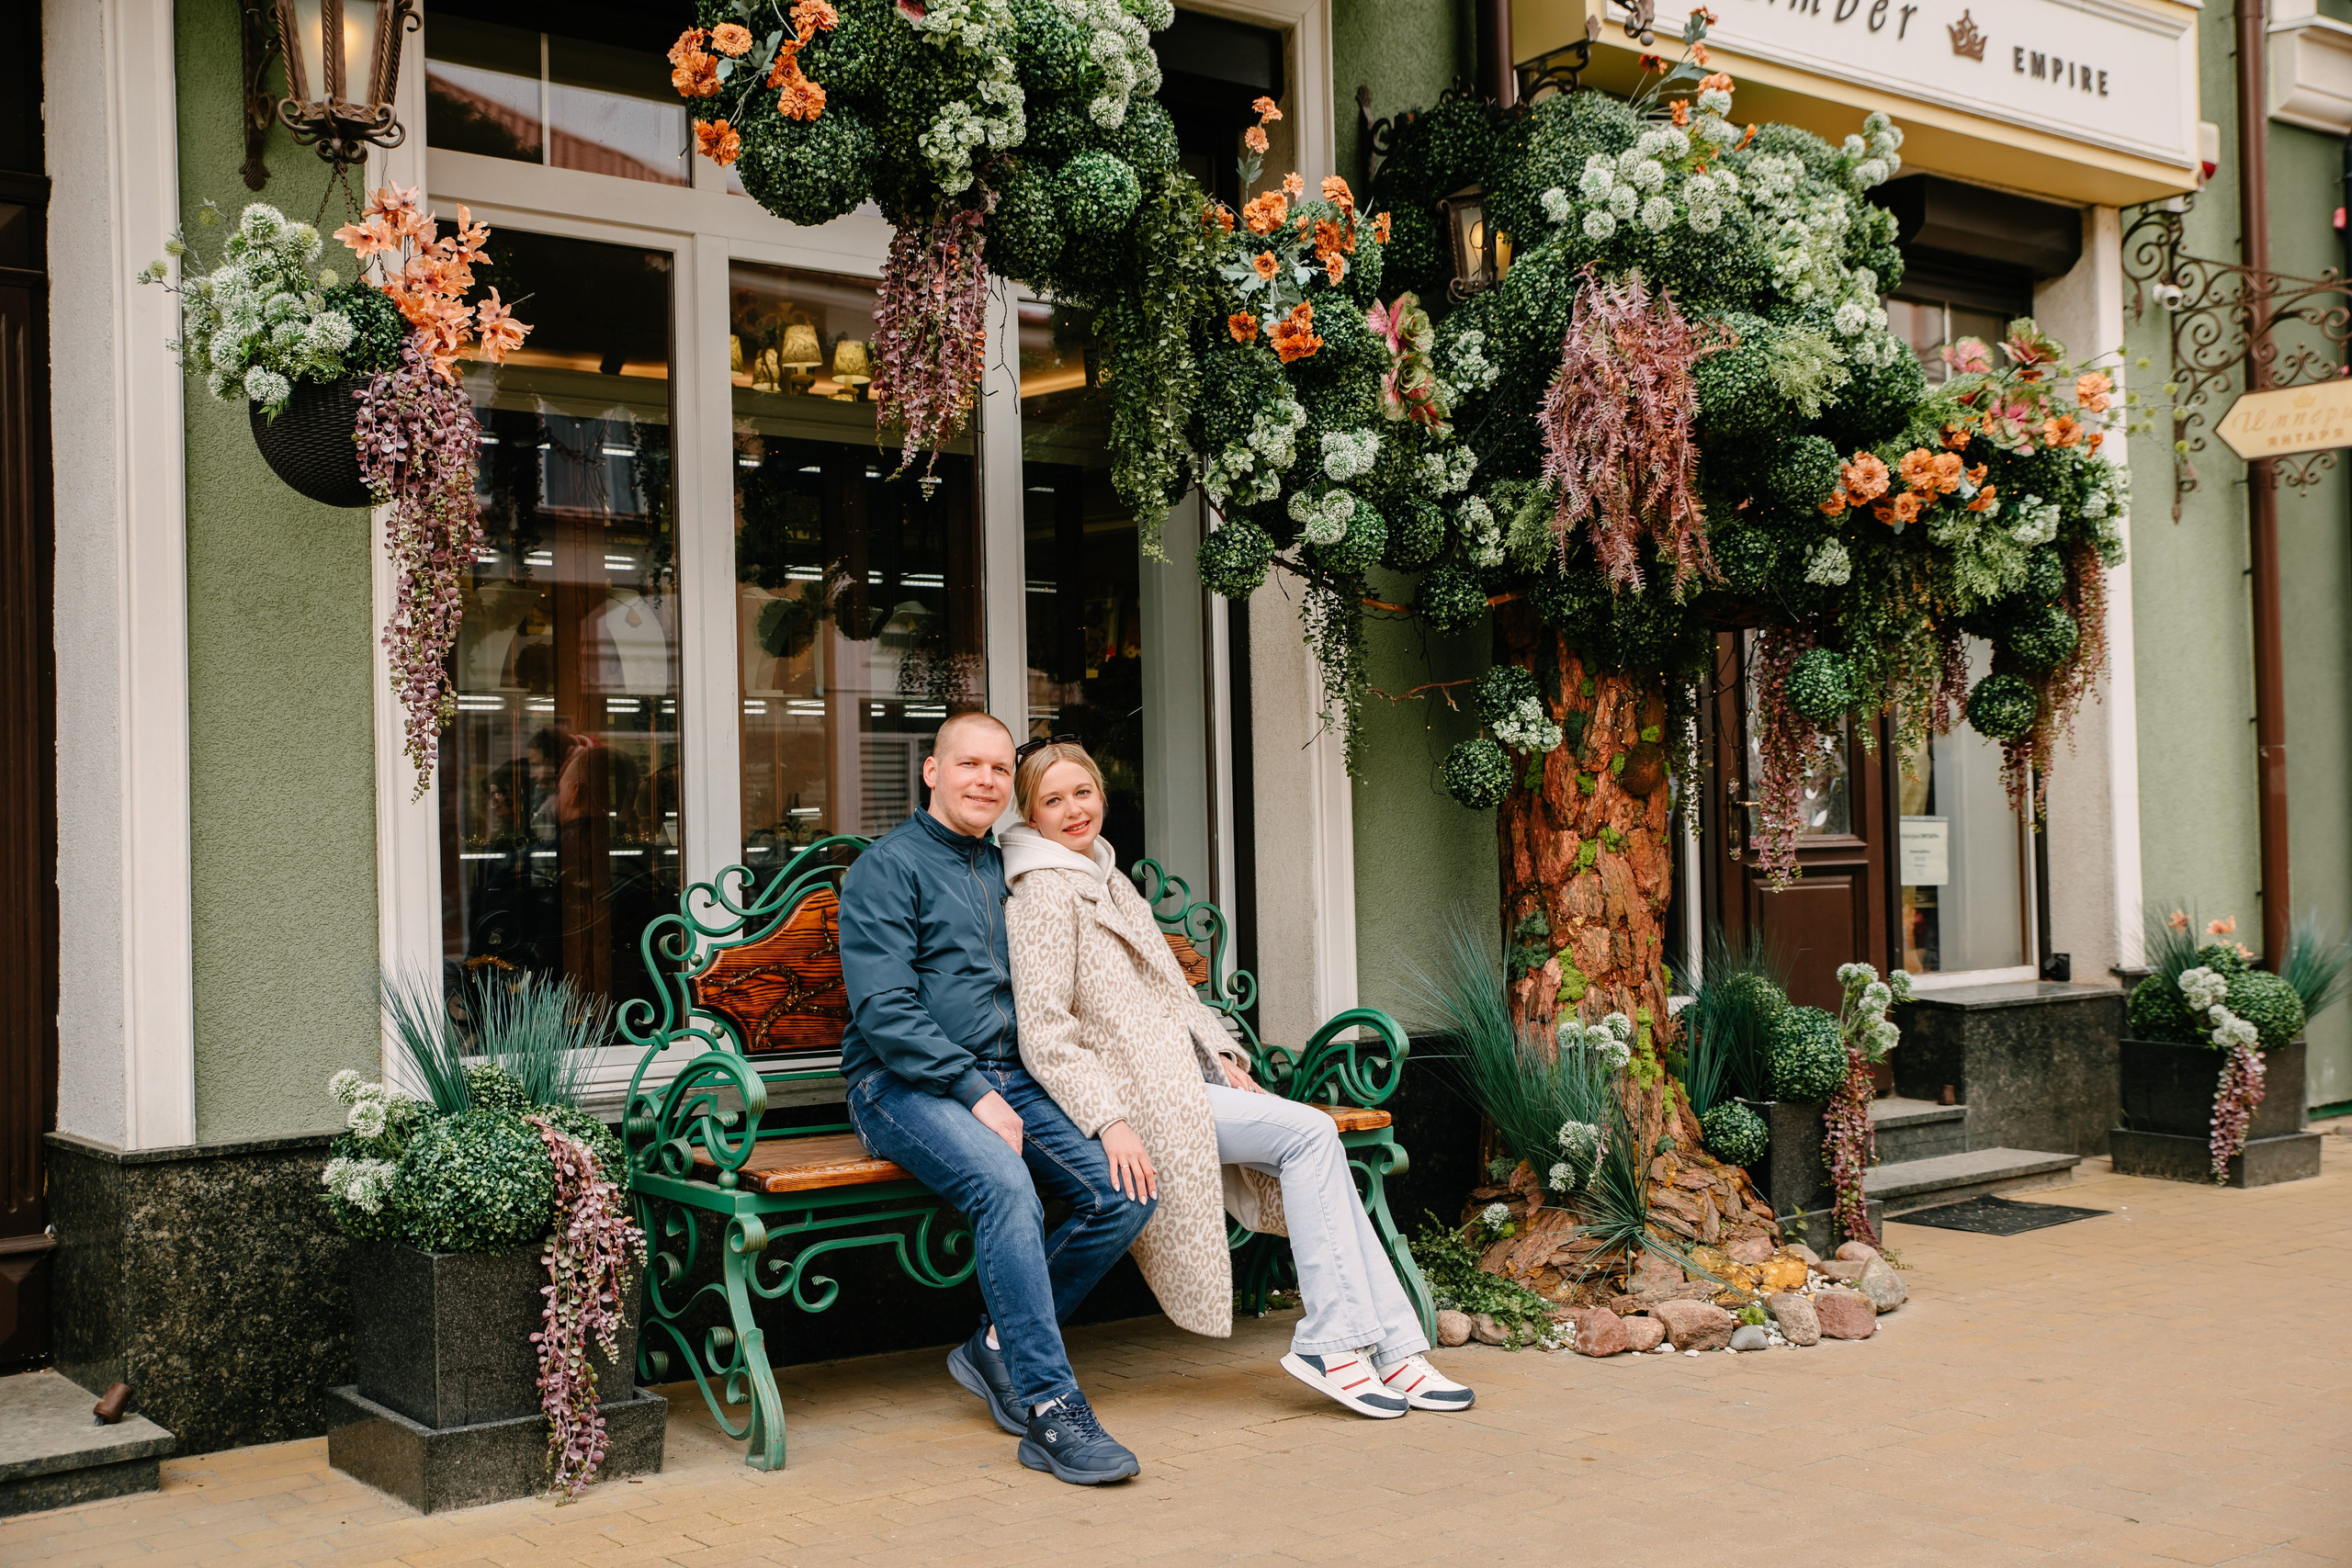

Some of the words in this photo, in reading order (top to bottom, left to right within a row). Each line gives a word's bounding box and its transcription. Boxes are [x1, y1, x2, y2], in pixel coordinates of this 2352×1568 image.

[1766, 0, 1918, 40] ber
[2012, 45, 2109, 96] EMPIRE
[2267, 427, 2344, 447] ЯНТАРЯ
